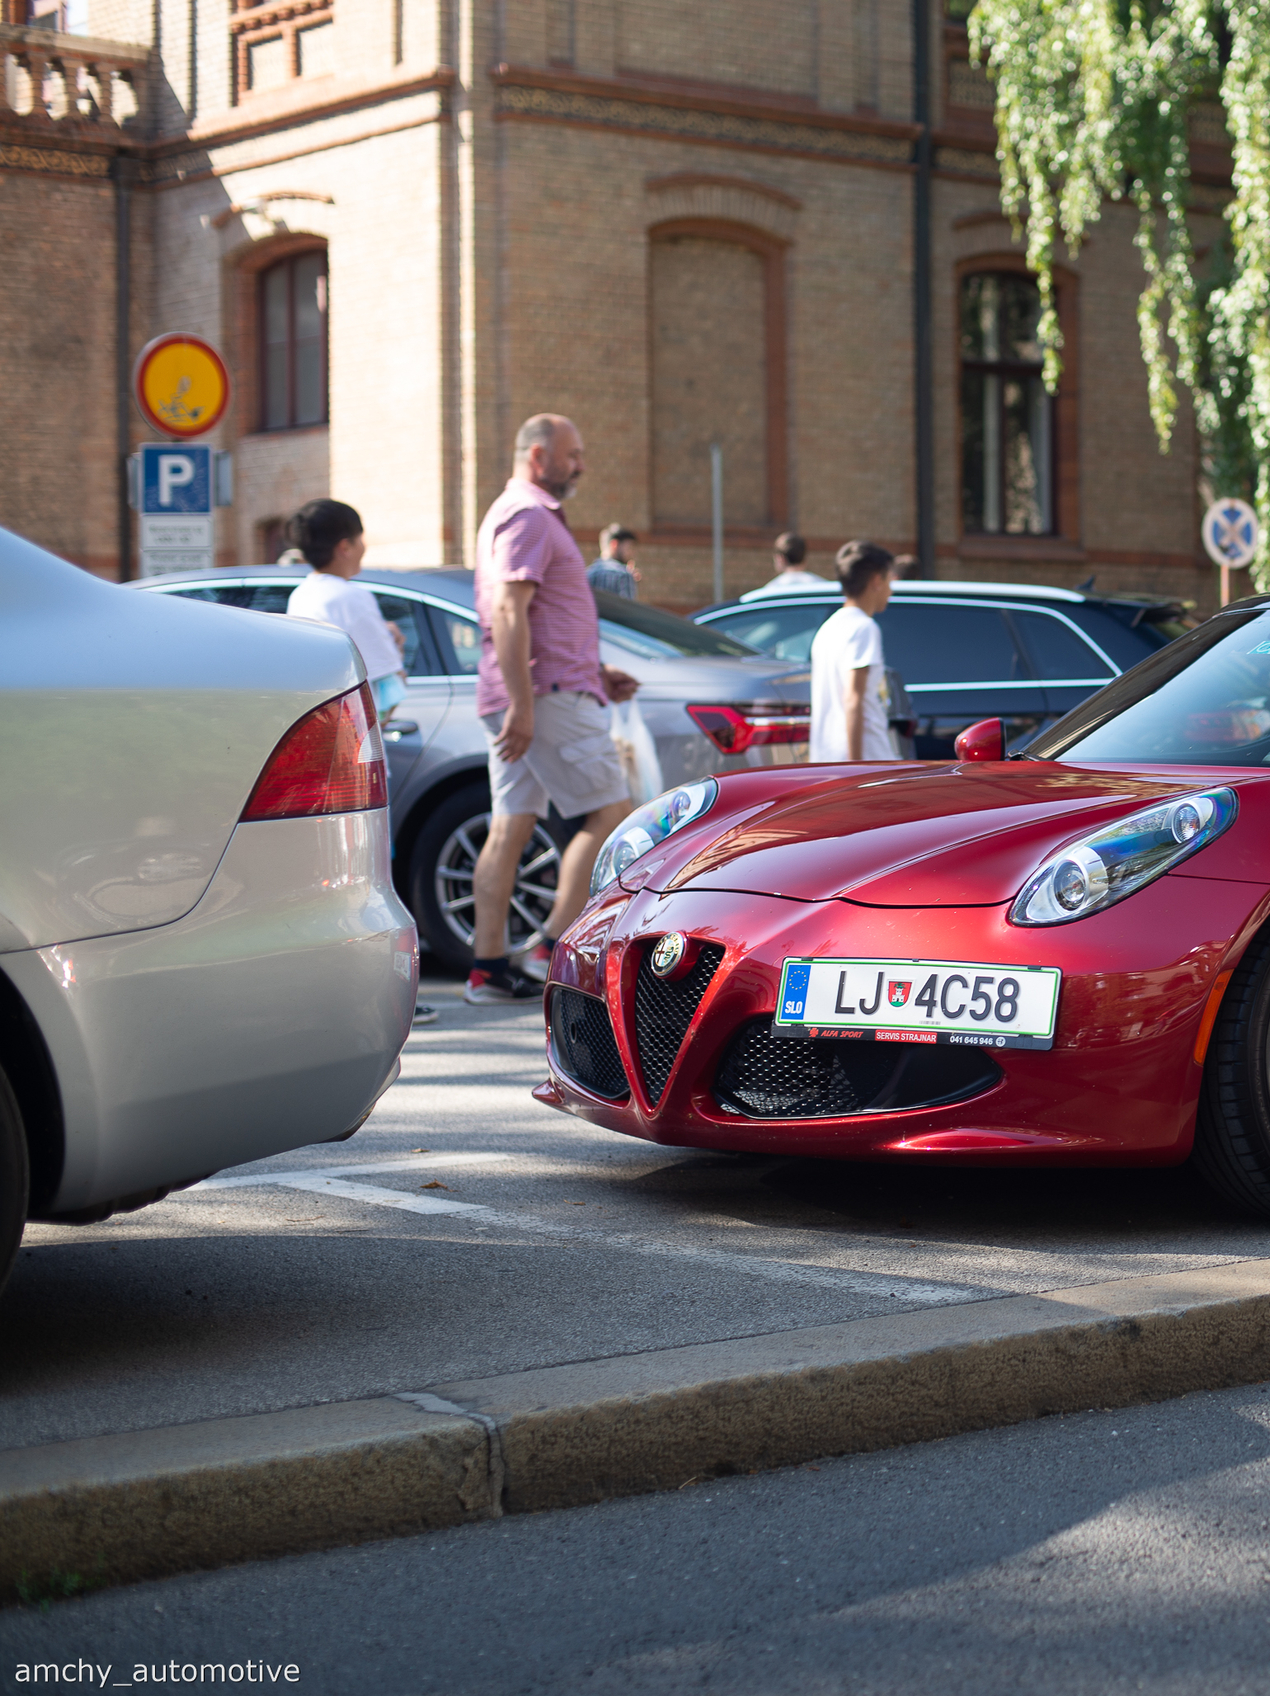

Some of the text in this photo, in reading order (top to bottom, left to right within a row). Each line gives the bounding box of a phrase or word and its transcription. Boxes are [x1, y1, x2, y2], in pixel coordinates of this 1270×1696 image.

[158, 454, 195, 507] P
[834, 970, 1020, 1022] LJ 4C58
[784, 1000, 804, 1014] SLO
[820, 1029, 864, 1039] ALFA SPORT
[876, 1031, 937, 1043] SERVIS STRAJNAR
[950, 1035, 994, 1046] 041 645 946
